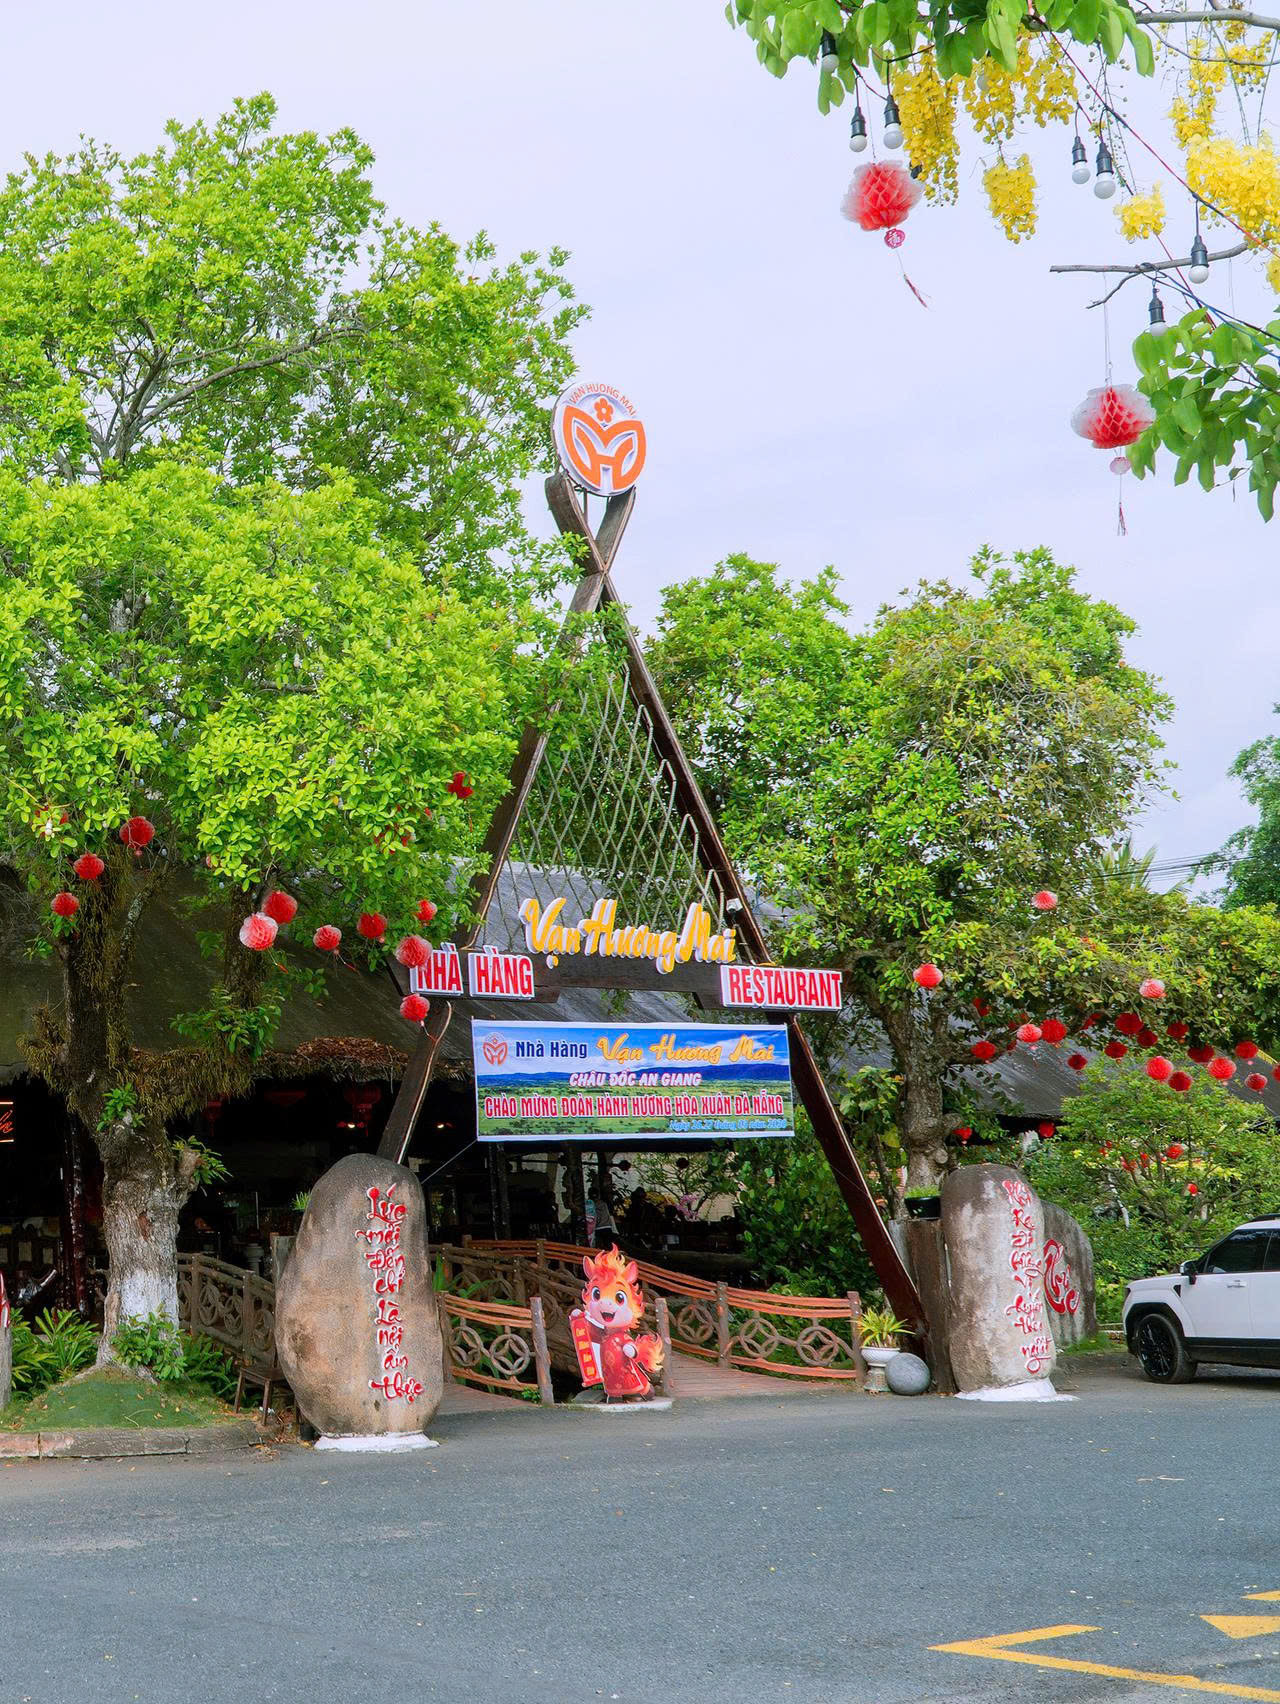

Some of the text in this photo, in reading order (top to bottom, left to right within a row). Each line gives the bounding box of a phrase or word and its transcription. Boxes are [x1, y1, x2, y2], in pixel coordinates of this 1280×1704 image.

[620, 395, 637, 417] MAI
[519, 897, 736, 975] Vạn Hương Mai
[414, 943, 534, 997] NHÀ HÀNG
[728, 968, 842, 1008] RESTAURANT
[516, 1033, 775, 1064] Nhà Hàng Vạn Hương Mai
[570, 1067, 703, 1087] CHÂU ĐỐC AN GIANG
[485, 1089, 784, 1118] CHÀO MỪNG ĐOÀN HÀNH HƯƠNG HÒA XUÂN ĐÀ NẴNG
[367, 1183, 408, 1223] Lúc
